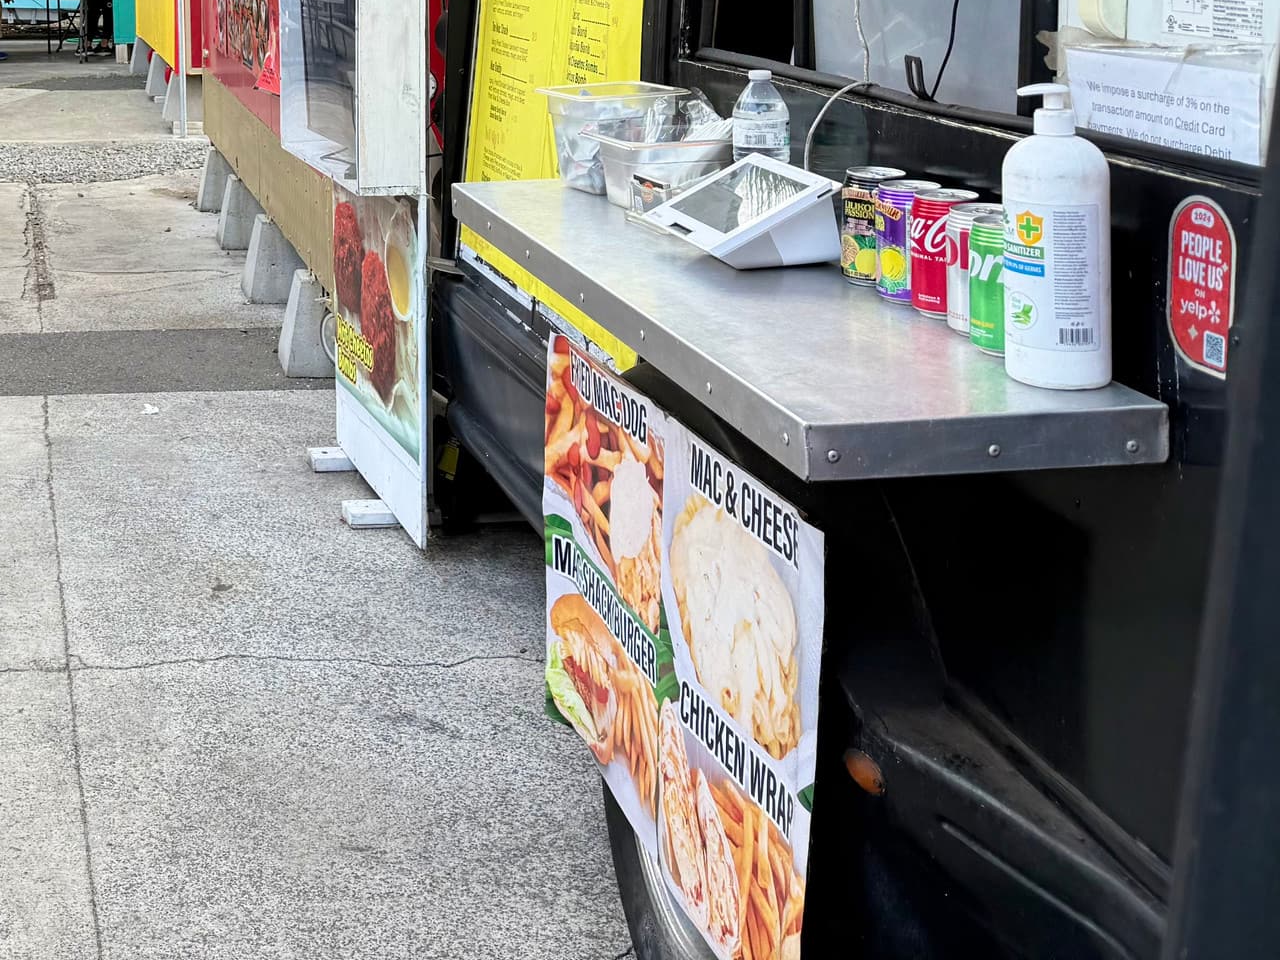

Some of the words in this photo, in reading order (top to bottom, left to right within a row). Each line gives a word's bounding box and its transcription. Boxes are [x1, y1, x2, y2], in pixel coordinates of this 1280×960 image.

[1087, 80, 1101, 93] We
[1101, 82, 1129, 100] impose
[1130, 90, 1136, 99] a
[1137, 90, 1175, 108] surcharge
[1176, 98, 1184, 109] of
[1185, 97, 1198, 110] 3%
[1199, 101, 1212, 114] on
[1213, 100, 1230, 116] the
[1092, 101, 1134, 119] transaction
[1135, 110, 1163, 126] amount
[1163, 116, 1174, 127] on
[1175, 116, 1200, 134] Credit
[1201, 120, 1226, 137] Card
[1126, 127, 1139, 139] We
[1139, 131, 1149, 143] do
[1150, 133, 1162, 144] not
[1204, 144, 1232, 161] Debit
[1194, 211, 1211, 223] 2024
[1007, 244, 1041, 258] SANITIZER
[1181, 230, 1223, 264] PEOPLE
[1024, 264, 1042, 273] GERMS
[1179, 255, 1206, 286] LOVE
[1207, 265, 1224, 292] US
[1180, 298, 1208, 321] yelp
[1194, 288, 1206, 299] ON
[570, 350, 591, 401] FRIED
[593, 371, 621, 423] MAC
[621, 396, 647, 445] DOG
[691, 443, 721, 506] MAC
[725, 469, 737, 519] &
[741, 482, 799, 569] CHEESE
[582, 560, 614, 625] SHACK
[614, 599, 657, 684] BURGER
[680, 680, 745, 781] CHICKEN
